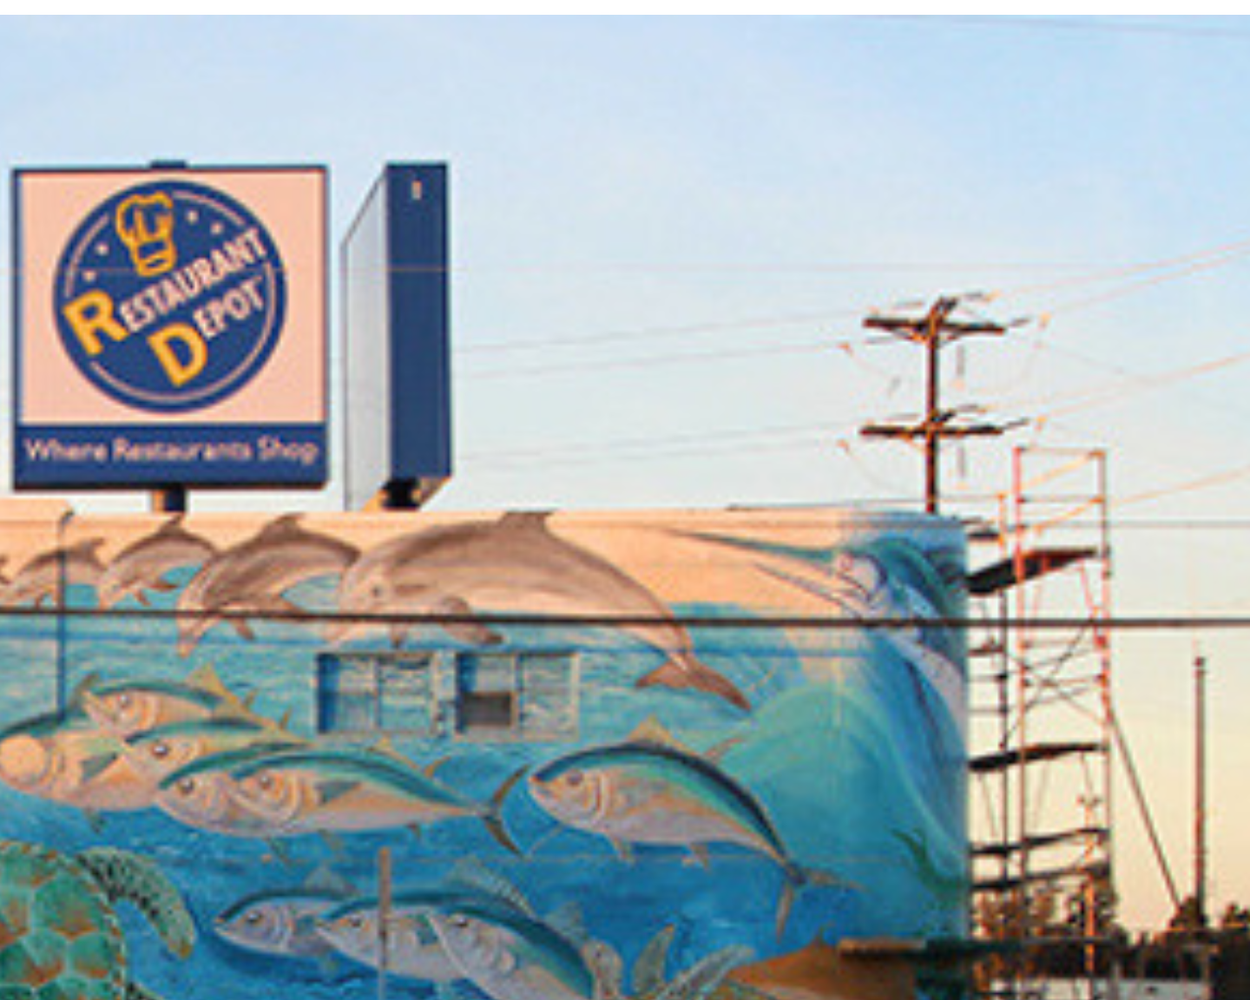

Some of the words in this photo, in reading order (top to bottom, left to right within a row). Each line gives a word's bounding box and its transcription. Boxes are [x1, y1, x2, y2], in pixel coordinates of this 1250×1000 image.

[62, 227, 268, 356] RESTAURANT
[147, 275, 264, 388] DEPOT
[23, 436, 108, 462] Where
[112, 436, 254, 462] Restaurants
[257, 434, 318, 466] Shop
